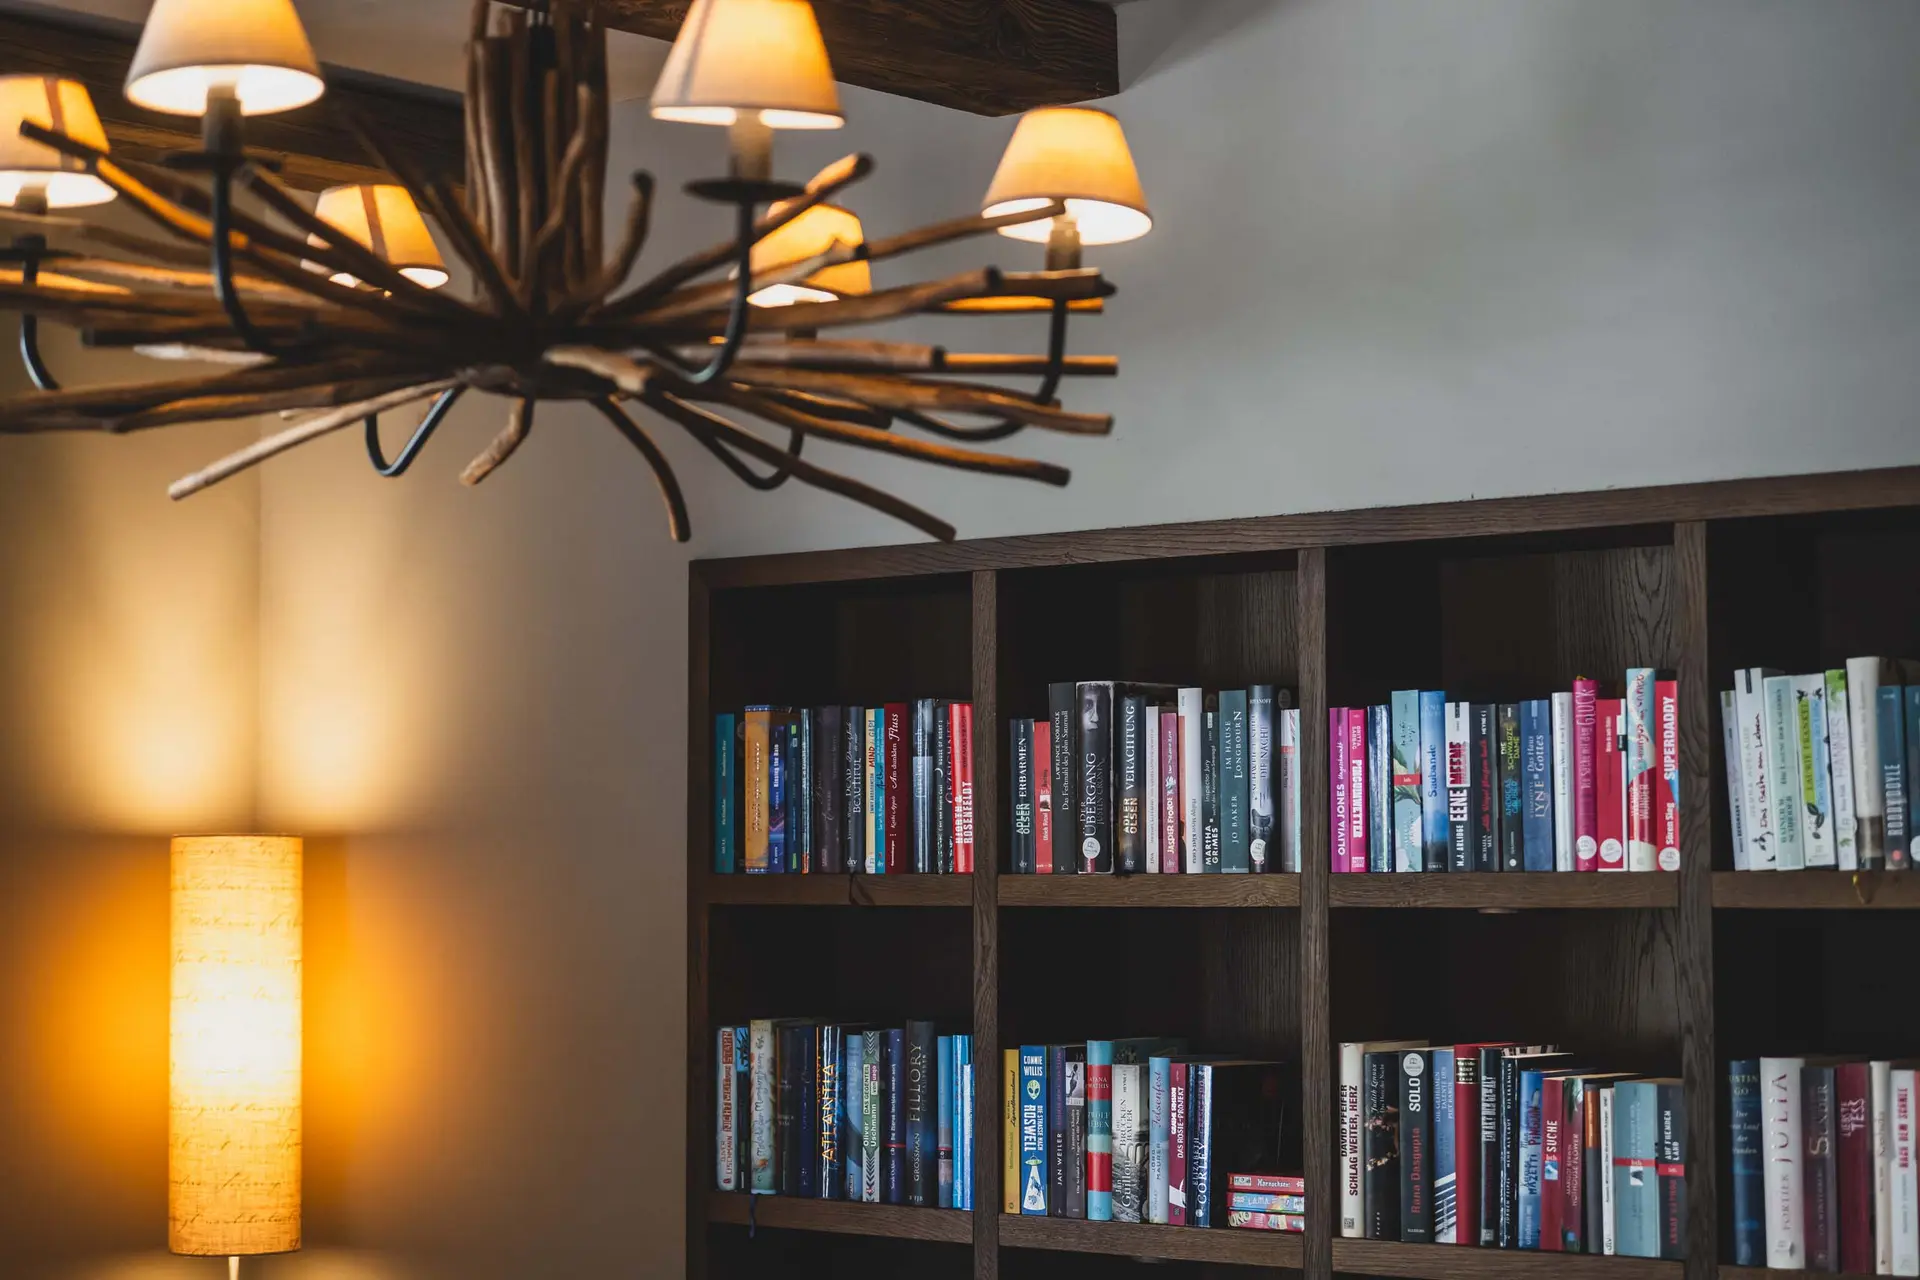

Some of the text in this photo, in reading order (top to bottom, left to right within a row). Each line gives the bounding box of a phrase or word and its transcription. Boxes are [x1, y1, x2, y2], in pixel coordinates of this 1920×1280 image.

[888, 713, 901, 742] Fluss
[1126, 705, 1135, 790] VERACHTUNG
[1233, 710, 1243, 779] LONGBOURN
[1506, 725, 1514, 770] SCHWARZE
[1663, 696, 1675, 781] SUPERDADDY
[890, 743, 898, 769] dunklen
[1018, 737, 1028, 797] ERBARMEN
[1427, 744, 1437, 797] Saubande
[1449, 741, 1462, 785] MEENE
[1534, 734, 1545, 772] Gottes
[852, 757, 861, 813] BEAUTIFUL
[1082, 753, 1097, 837] ÜBERGANG
[1352, 759, 1363, 839] PINGUINWETTER
[1449, 788, 1468, 821] EENE
[1504, 778, 1513, 816] ANDREAS
[1511, 780, 1519, 813] GRUBER
[1534, 780, 1546, 817] LYNE
[1884, 763, 1903, 836] RODDY DOYLE
[962, 780, 972, 844] ROSENFELDT
[1016, 803, 1024, 834] ADLER
[1022, 803, 1030, 834] OLSEN
[1129, 797, 1138, 834] OLSEN
[1336, 783, 1346, 856] OLIVIA JONES
[1166, 825, 1175, 854] JASPER
[1231, 832, 1239, 844] JO
[1456, 824, 1464, 851] ARLIDGE
[909, 1041, 921, 1122] FILLORY
[1024, 1055, 1043, 1066] CONNIE
[1024, 1066, 1043, 1077] WILLIS
[1150, 1071, 1163, 1129] Felsenfest
[1370, 1063, 1378, 1113] Judith Lennox
[1408, 1077, 1421, 1112] SOLO
[821, 1063, 837, 1161] ATLANTIA
[1023, 1104, 1037, 1152] ROSWELL
[1340, 1084, 1348, 1157] DAVID PFEIFER
[1769, 1073, 1793, 1164] JULIA
[1850, 1098, 1865, 1133] TESS
[1348, 1085, 1359, 1196] SCHLAG WEITER, HERZ
[1546, 1120, 1557, 1153] SUCHE
[1664, 1145, 1672, 1160] AUF
[1672, 1141, 1680, 1161] LAND
[1121, 1158, 1132, 1207] Guillou
[1198, 1141, 1207, 1205] CORLEY
[1411, 1127, 1422, 1214] Rana Dasgupta
